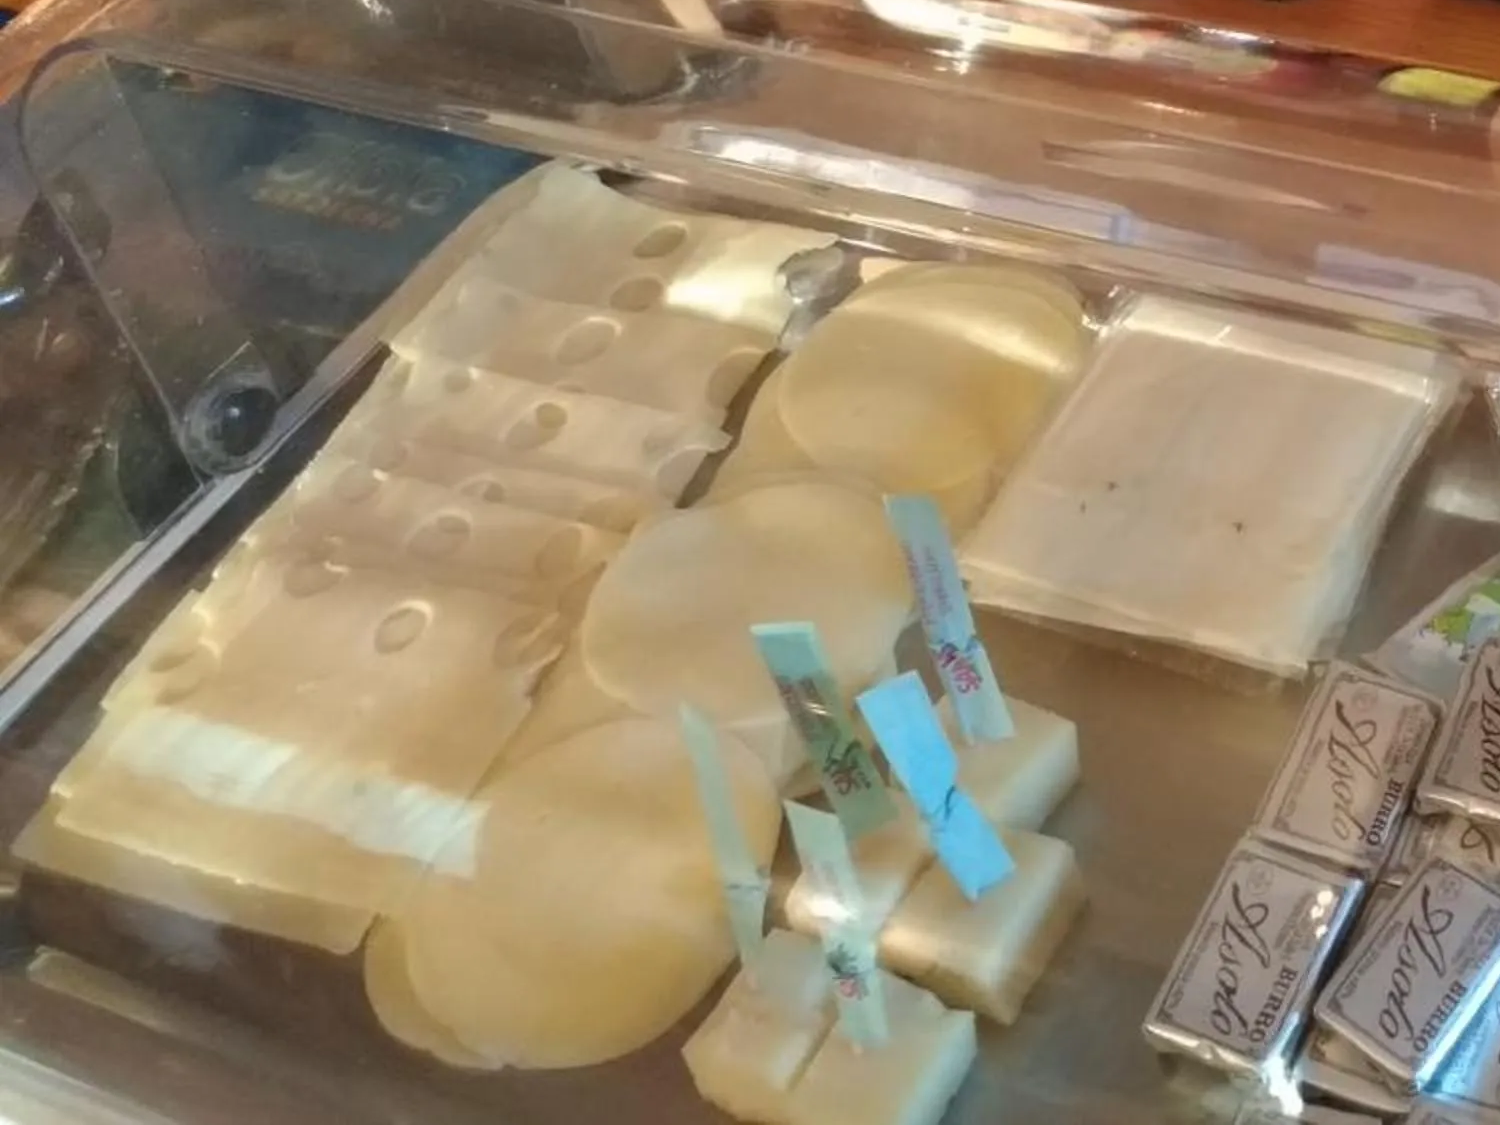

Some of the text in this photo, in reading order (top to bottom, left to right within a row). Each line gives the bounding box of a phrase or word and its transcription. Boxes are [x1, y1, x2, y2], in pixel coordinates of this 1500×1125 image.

[1326, 698, 1382, 842] Asolo
[1365, 777, 1406, 847] BURRO
[1210, 880, 1271, 1037] Asolo
[1249, 963, 1299, 1043] BURRO
[1378, 883, 1455, 1040] Asolo
[1412, 979, 1468, 1054] BURRO
